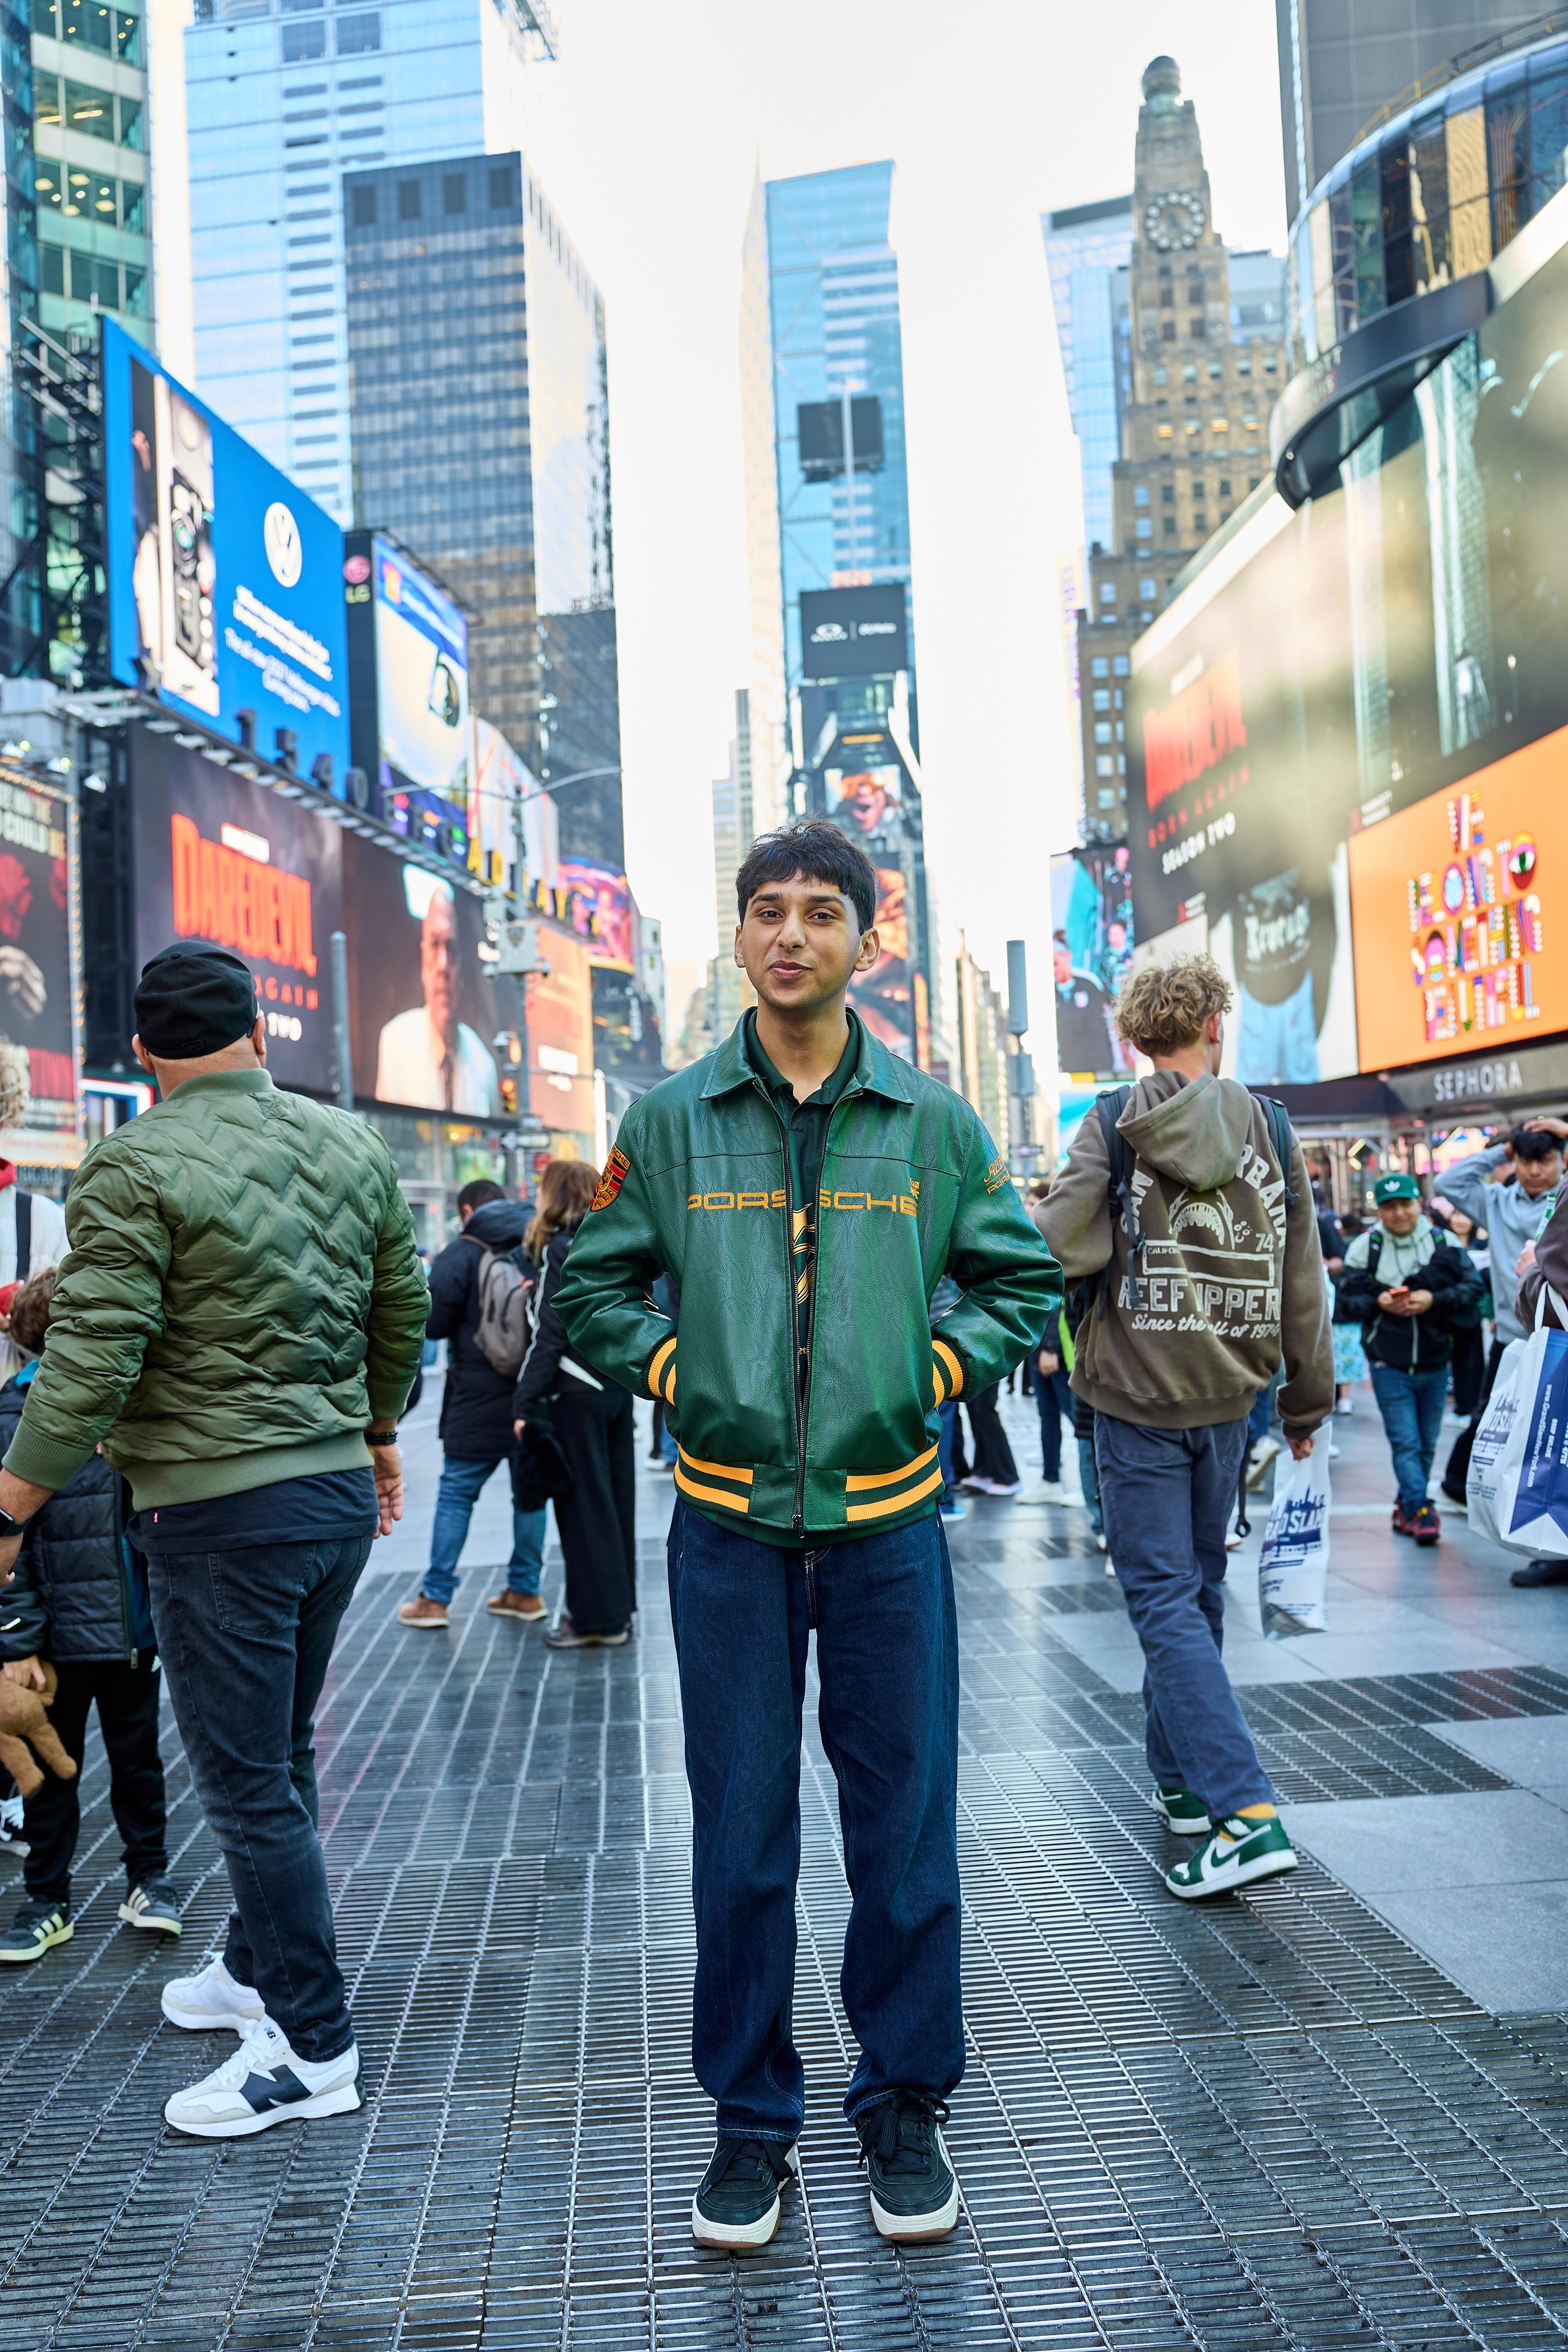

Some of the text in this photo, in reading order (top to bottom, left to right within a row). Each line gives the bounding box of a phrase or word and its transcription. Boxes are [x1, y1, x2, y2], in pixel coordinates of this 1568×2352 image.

[345, 584, 370, 604] LG
[1162, 812, 1235, 875] SEASON TWO
[1496, 830, 1536, 898] TO
[267, 1012, 301, 1041] TWO
[1433, 1060, 1523, 1101] SEPHORA
[1255, 1233, 1274, 1252] 74
[1118, 1275, 1280, 1321] REEF IPPER
[1132, 1313, 1176, 1331] Since
[1177, 1313, 1207, 1331] the
[1230, 1323, 1250, 1338] of
[1527, 1384, 1552, 1487] www.GrandSlamNewYork.com
